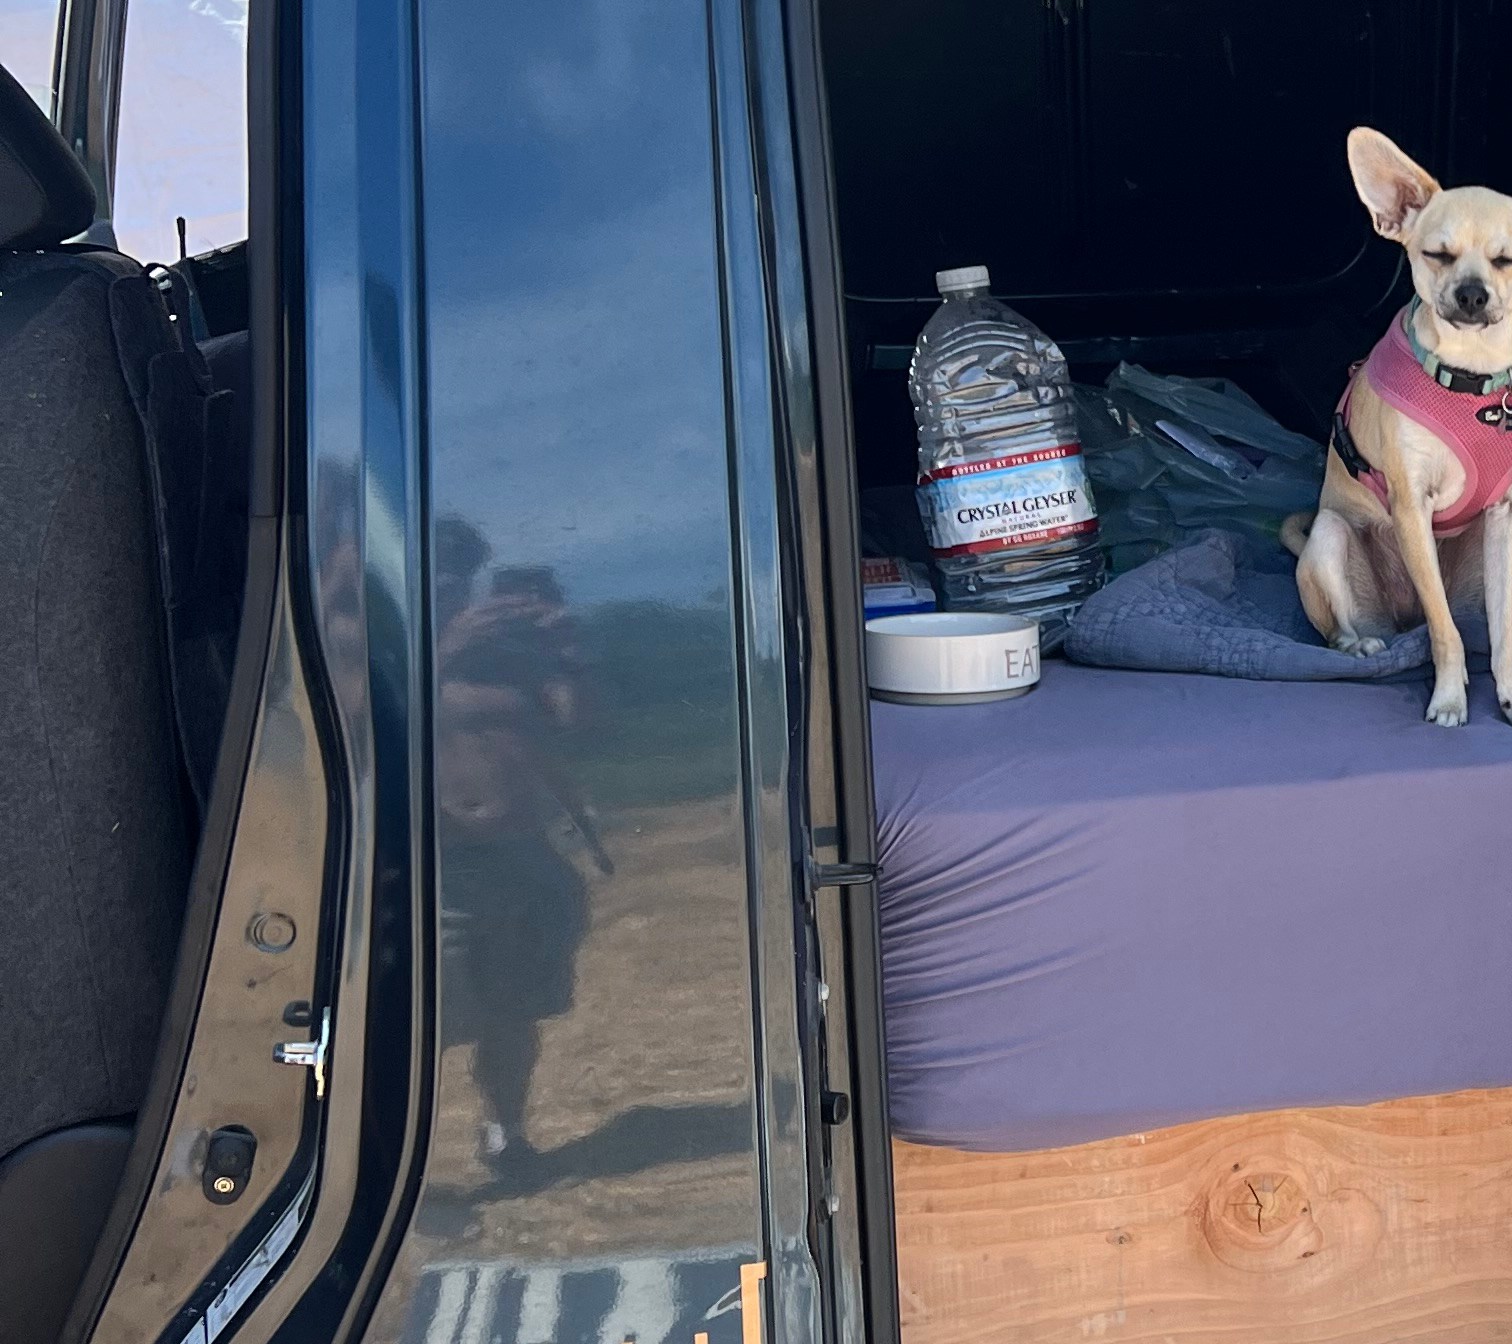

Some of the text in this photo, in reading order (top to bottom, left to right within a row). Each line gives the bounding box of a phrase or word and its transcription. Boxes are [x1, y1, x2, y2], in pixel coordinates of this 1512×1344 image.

[957, 490, 1077, 524] CRYSTAL GEYSER
[979, 516, 1067, 537] ALPINE SPRING WATER
